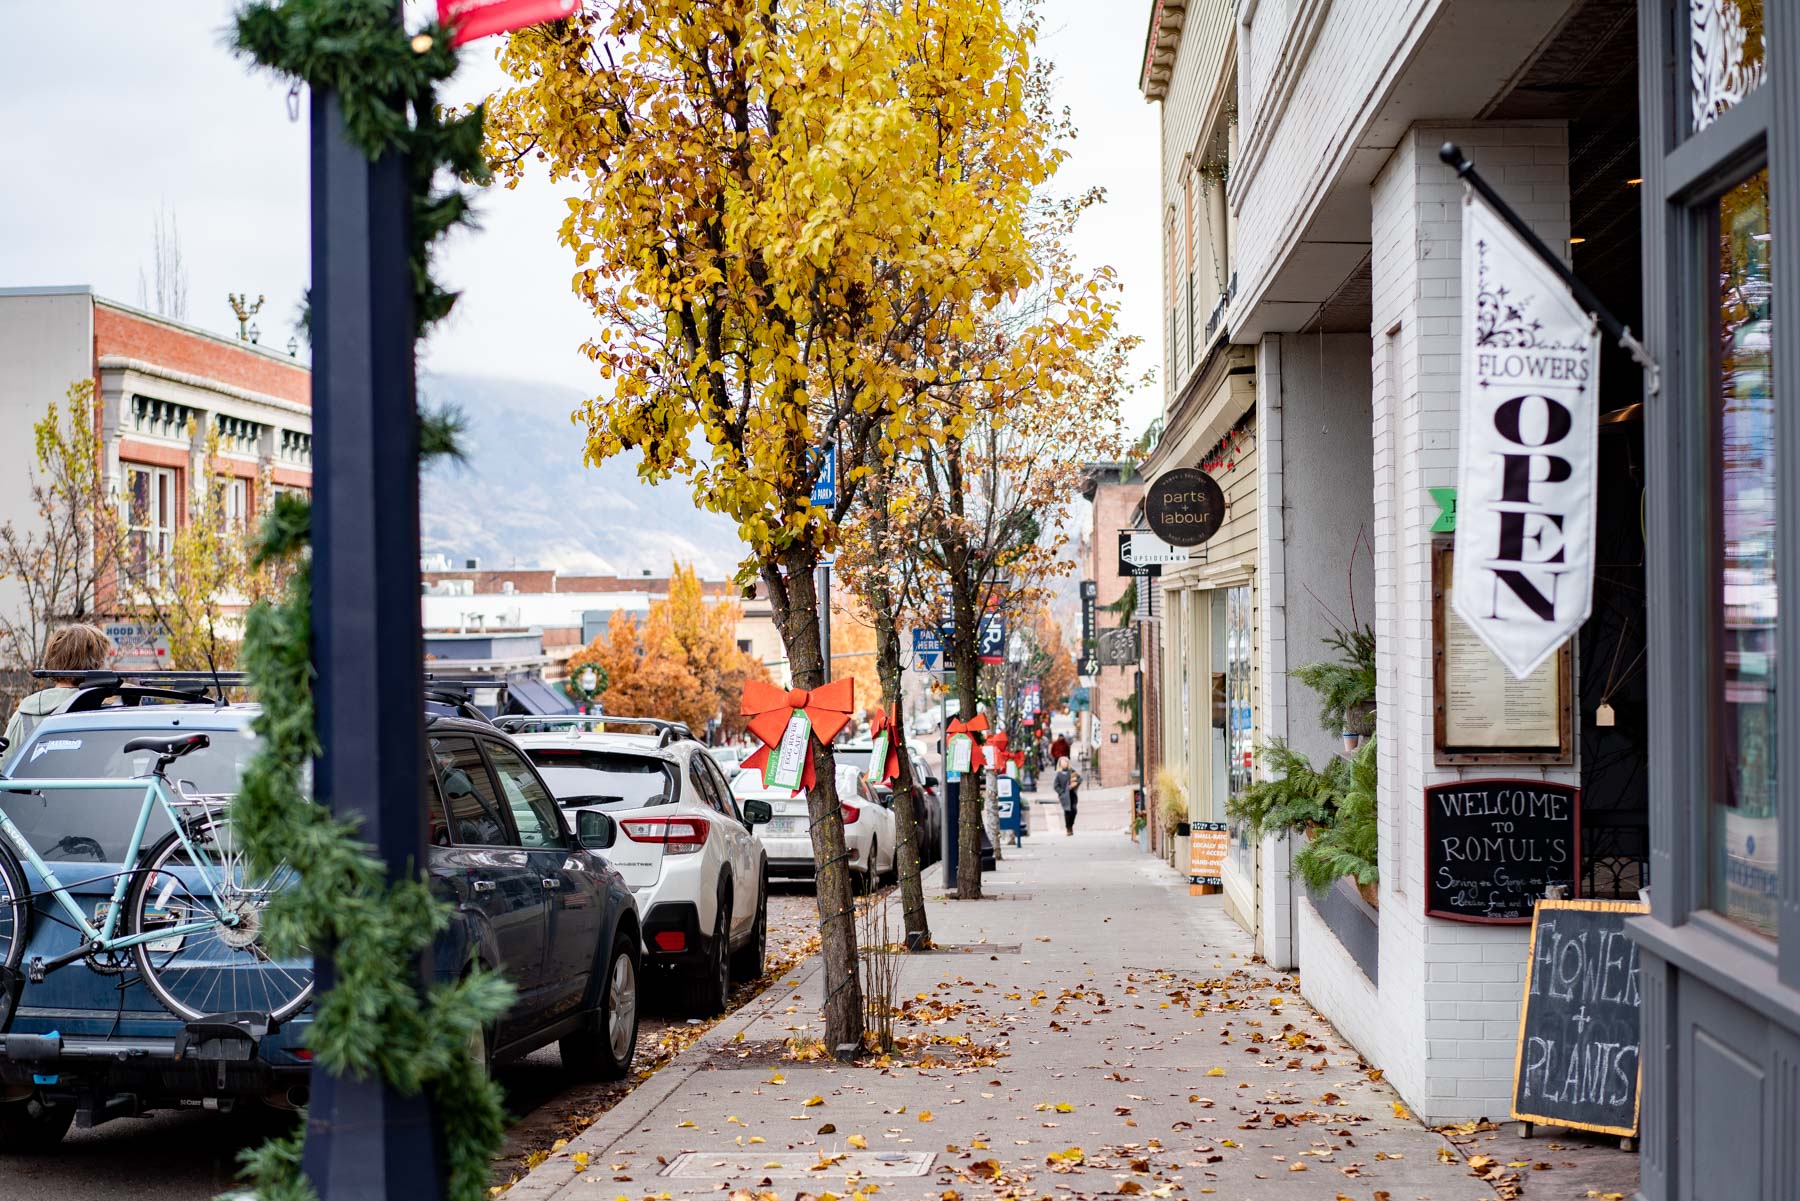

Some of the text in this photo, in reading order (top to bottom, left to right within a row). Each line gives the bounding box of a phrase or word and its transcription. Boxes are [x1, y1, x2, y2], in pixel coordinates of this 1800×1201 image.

[1478, 353, 1590, 382] FLOWERS
[1163, 490, 1206, 507] parts
[1480, 394, 1573, 622] OPEN
[1160, 511, 1210, 524] labour
[106, 627, 134, 636] HOOD
[920, 630, 935, 640] PAY
[918, 640, 939, 650] HERE
[1085, 659, 1099, 675] 45
[1438, 790, 1568, 821] WELCOME
[1491, 821, 1514, 833] TO
[1441, 836, 1567, 863] ROMUL'S
[1523, 1036, 1640, 1105] PLANTS
